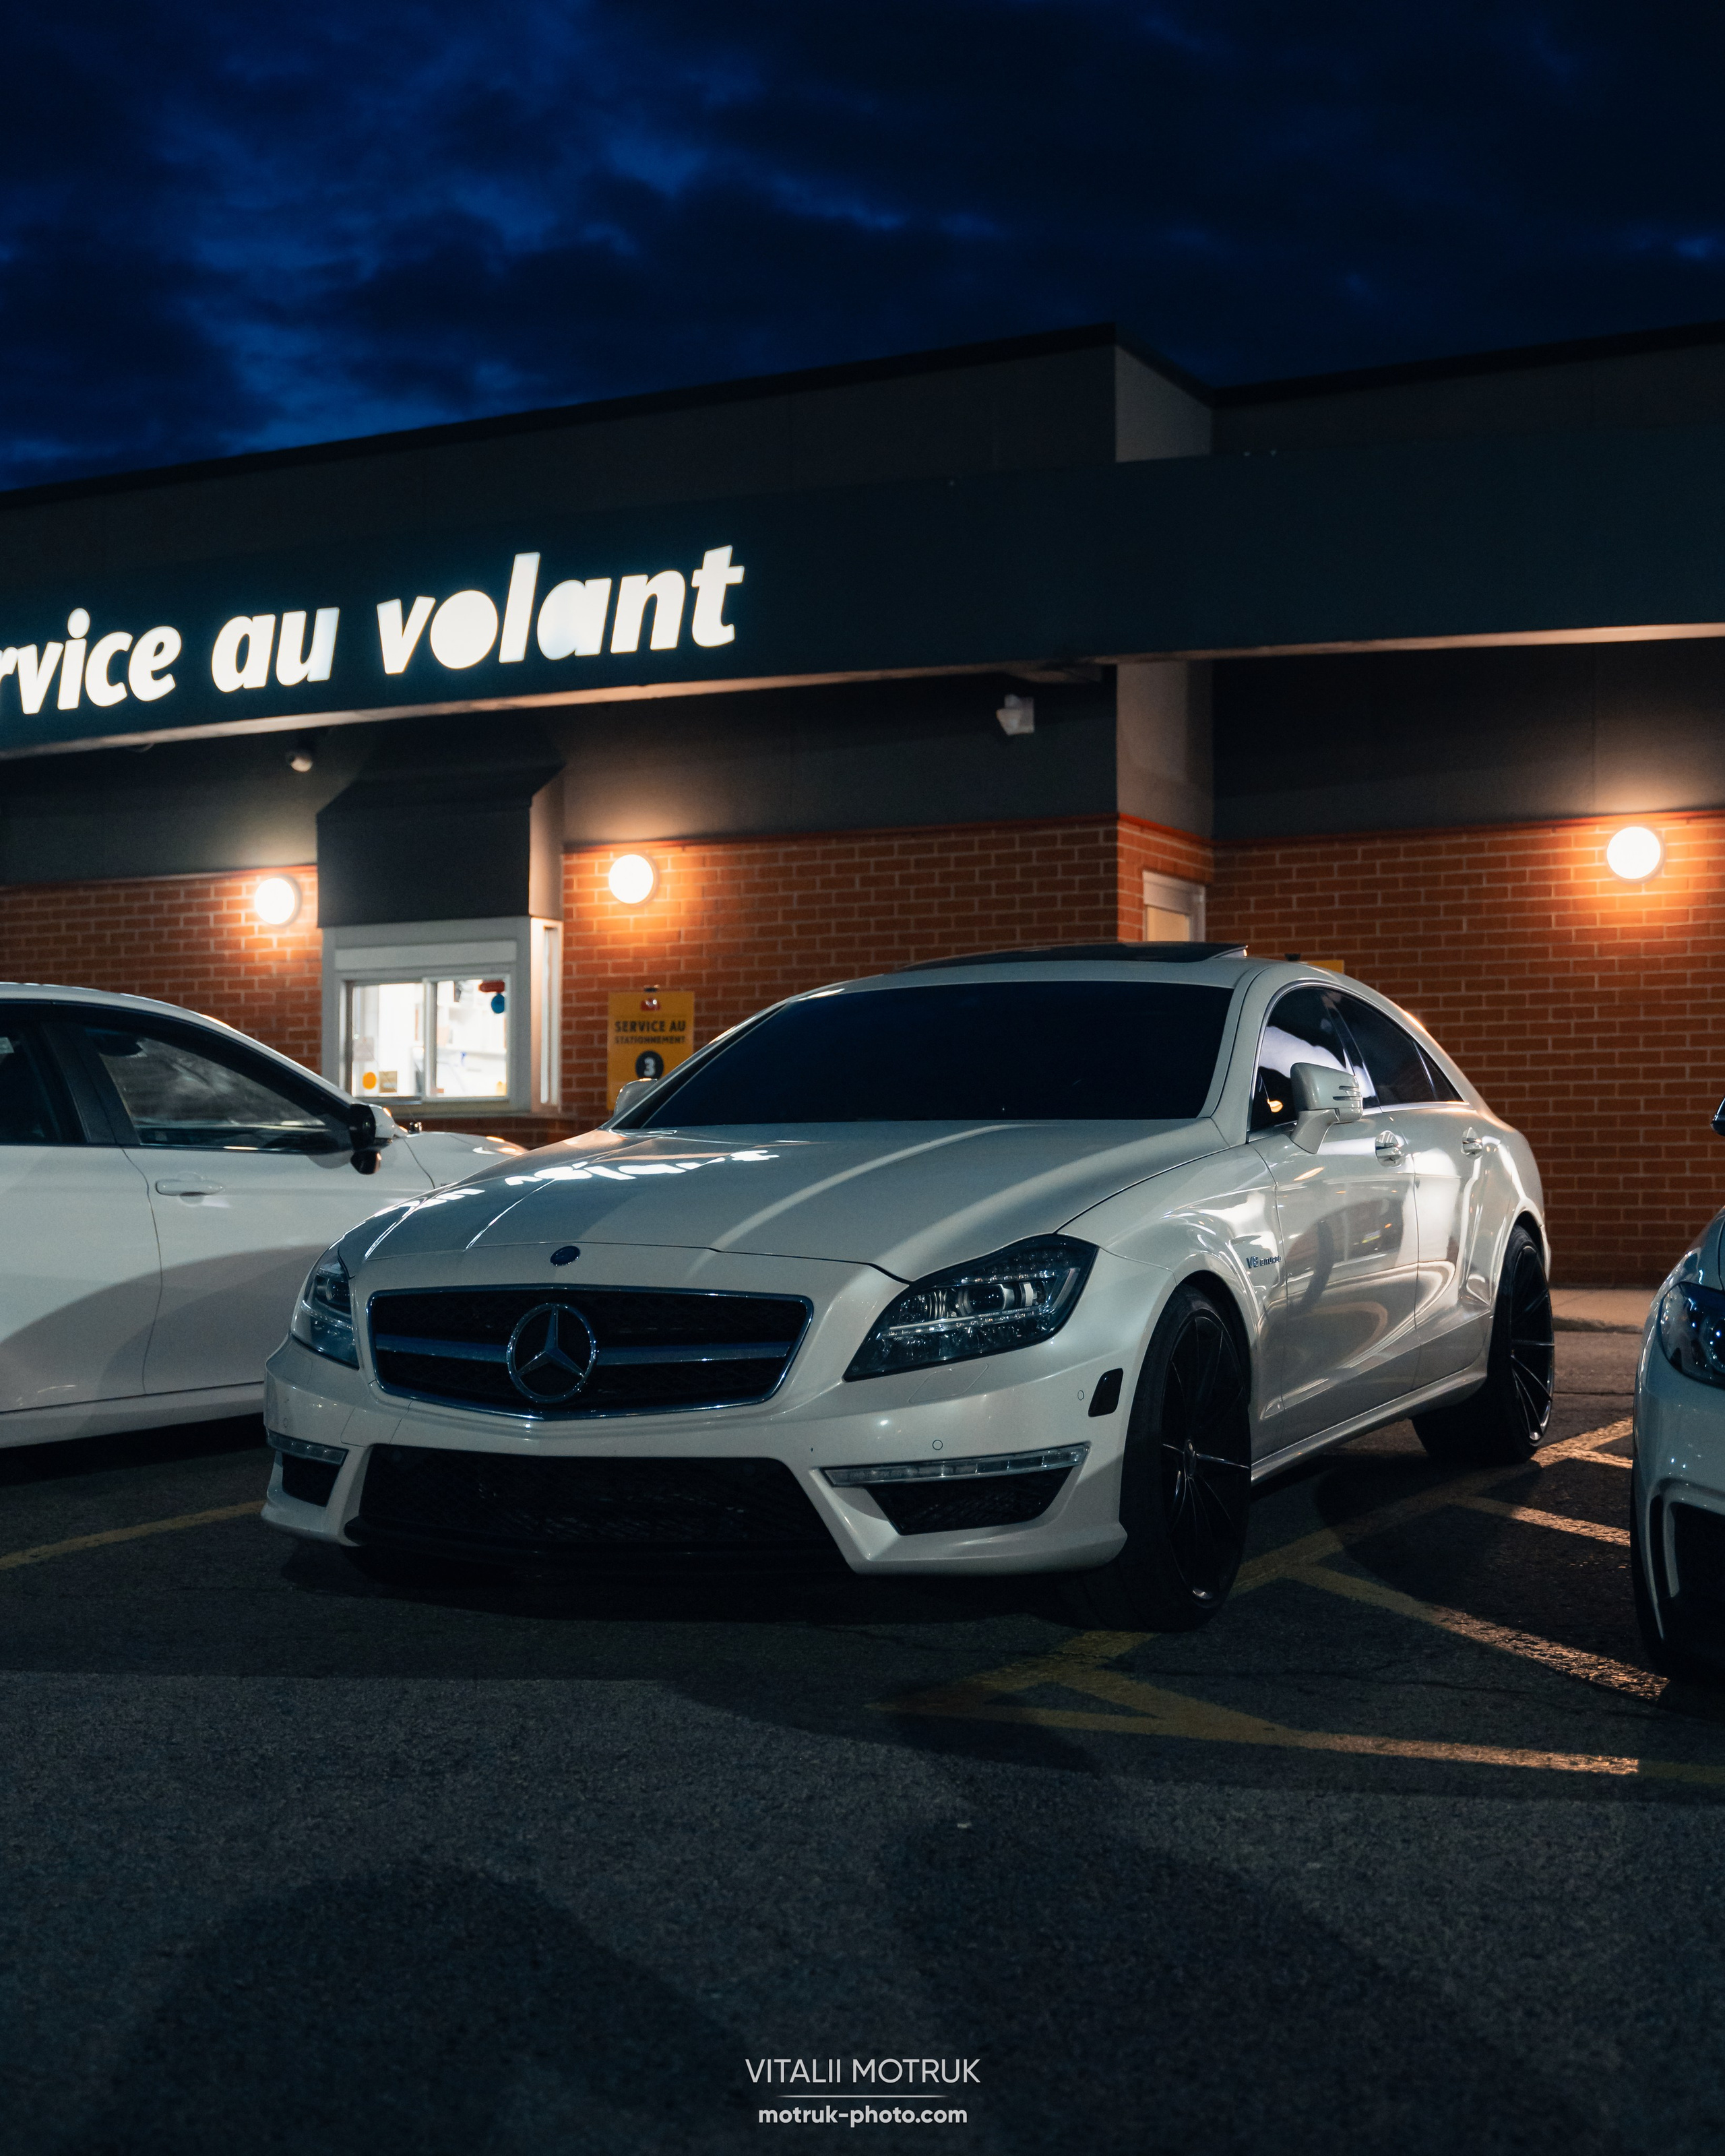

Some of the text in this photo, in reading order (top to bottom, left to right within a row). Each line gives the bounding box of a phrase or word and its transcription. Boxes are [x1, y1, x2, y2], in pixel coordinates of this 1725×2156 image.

[211, 607, 340, 693] au
[376, 545, 745, 674] volant
[615, 1020, 686, 1032] SERVICE AU
[615, 1036, 685, 1044] STATIONNEMENT
[644, 1057, 656, 1077] 3
[1246, 1255, 1259, 1269] V8
